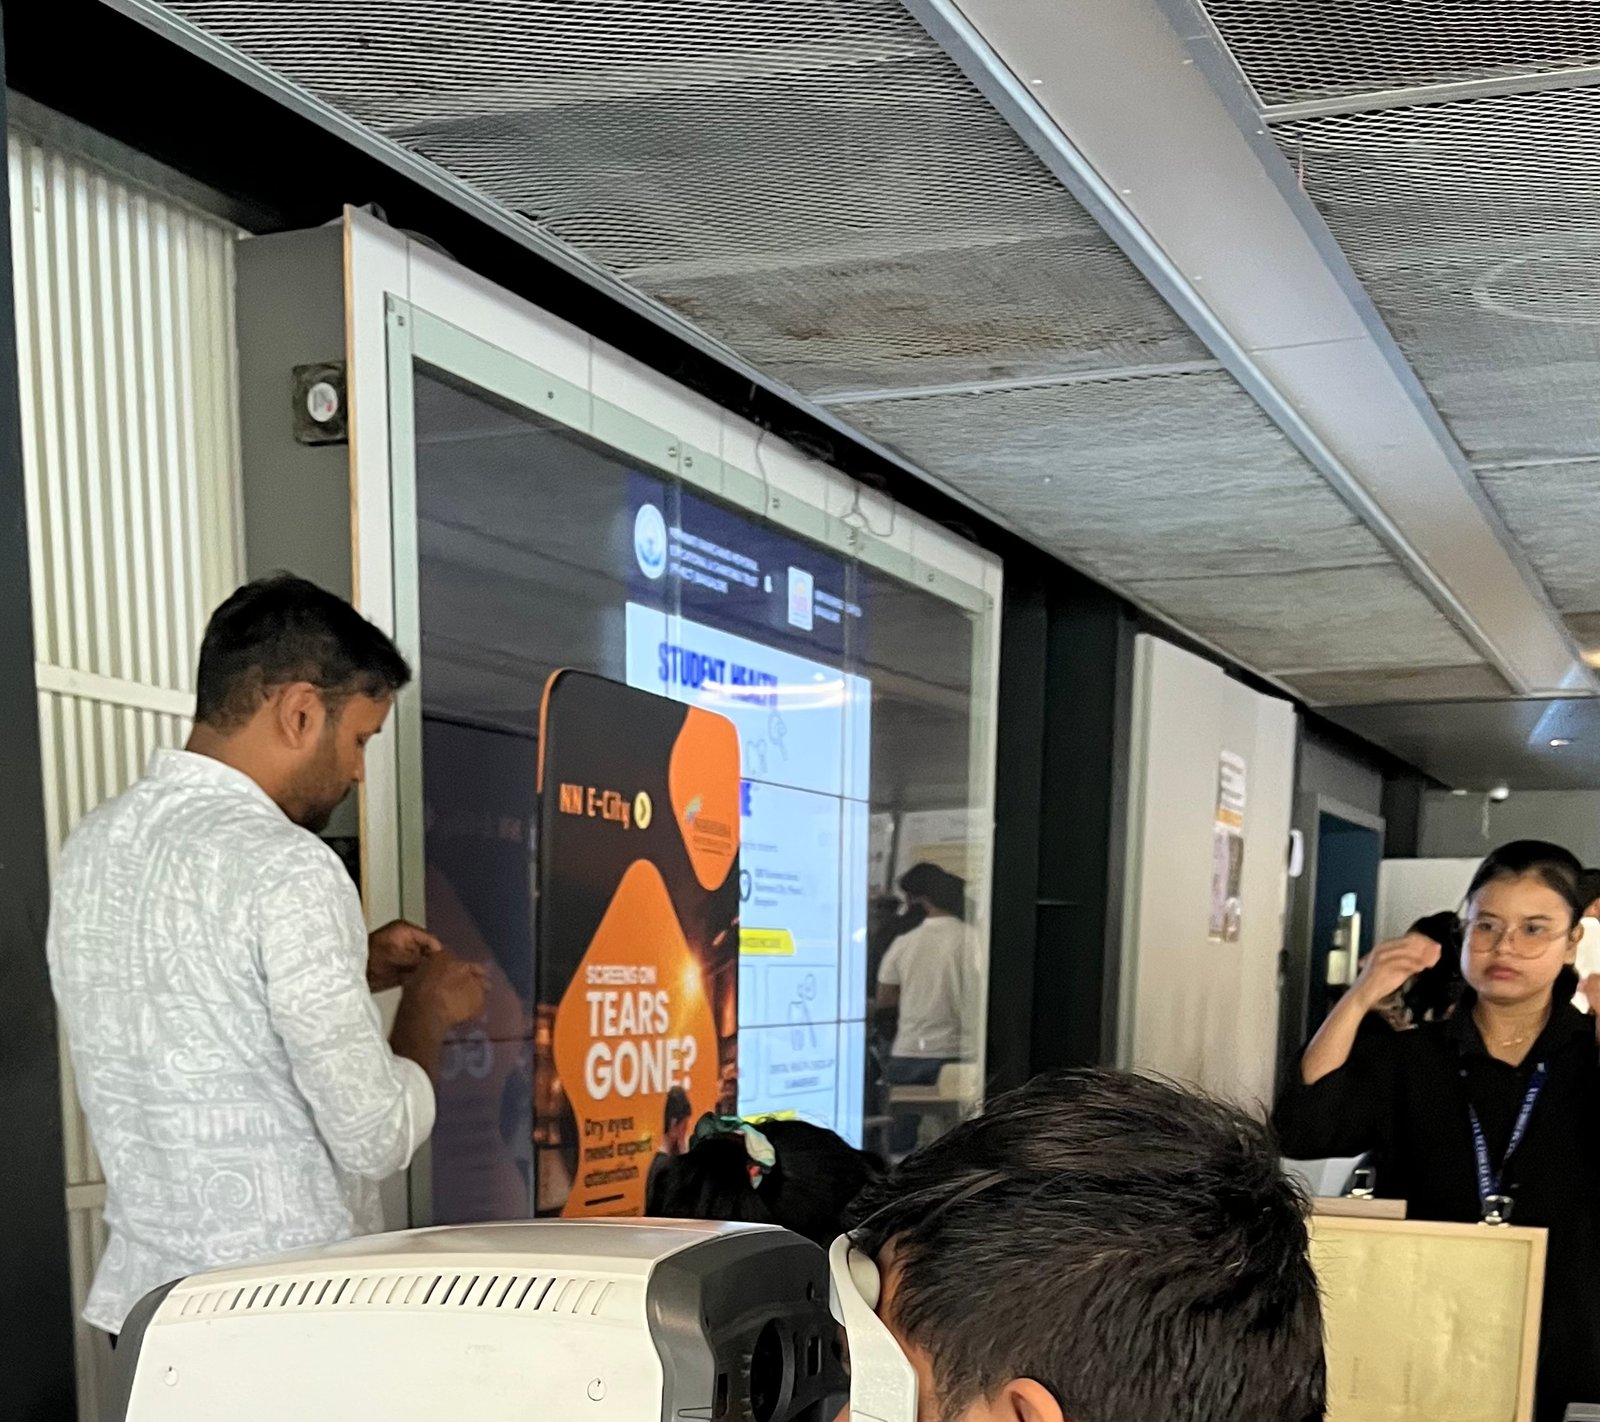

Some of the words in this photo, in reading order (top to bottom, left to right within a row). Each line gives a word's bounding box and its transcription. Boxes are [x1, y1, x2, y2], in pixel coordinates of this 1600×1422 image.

[659, 642, 725, 691] STUDENT
[587, 786, 631, 831] E-City
[586, 990, 669, 1038] TEARS
[585, 1034, 697, 1100] GONE?
[585, 1118, 604, 1141] Dry
[608, 1116, 634, 1138] eyes
[584, 1163, 639, 1188] attention
